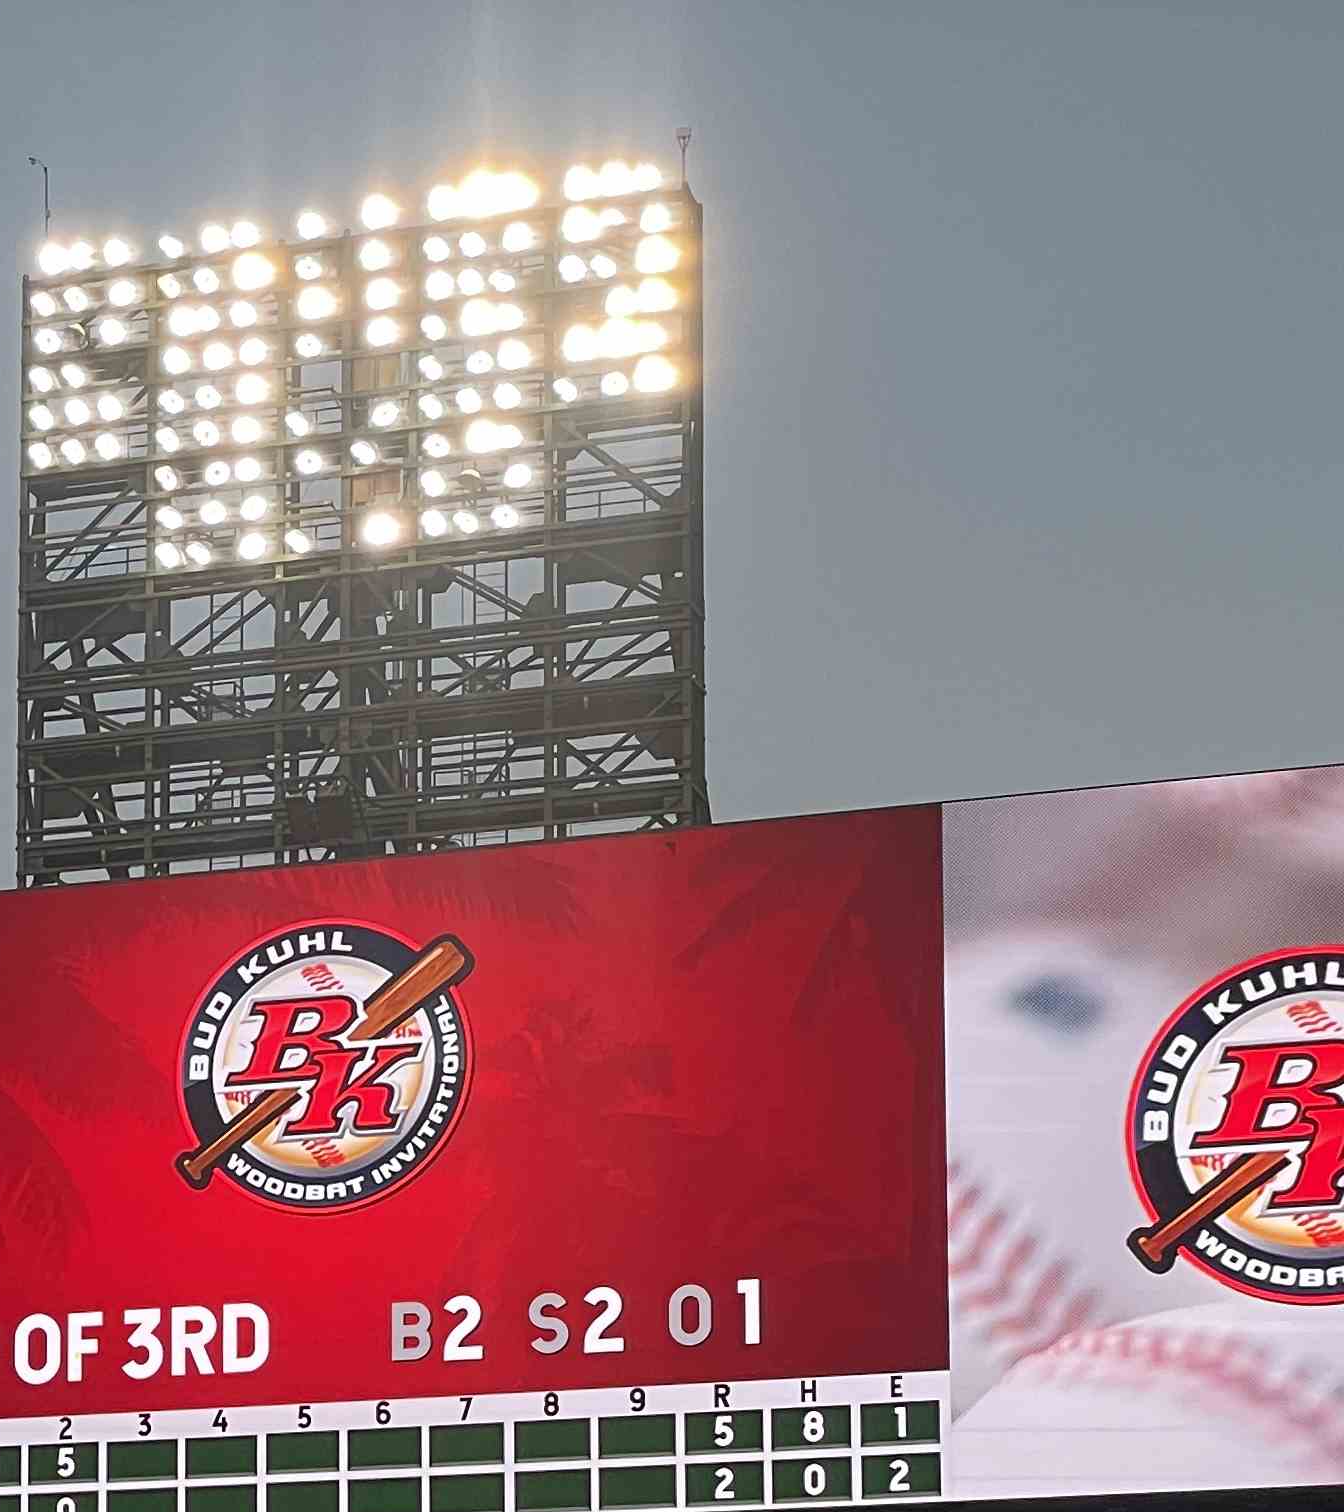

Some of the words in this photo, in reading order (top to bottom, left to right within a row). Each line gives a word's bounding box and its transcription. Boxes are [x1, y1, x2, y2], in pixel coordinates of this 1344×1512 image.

[189, 990, 232, 1081] BUD
[236, 931, 352, 985] KUHL
[225, 1152, 364, 1201] WOODBAT
[372, 994, 459, 1184] INVITATIONAL
[1142, 1034, 1198, 1143] BUD
[13, 1311, 105, 1384] OF
[121, 1303, 271, 1381] 3RD
[55, 1447, 76, 1478] 5
[713, 1414, 735, 1448] 5
[802, 1409, 826, 1444] 8
[892, 1405, 907, 1439] 1
[58, 1416, 73, 1441] 2
[137, 1412, 152, 1437] 3
[211, 1409, 229, 1434] 4
[296, 1406, 313, 1430] 5
[375, 1400, 392, 1425] 6
[459, 1397, 474, 1422] 7
[543, 1392, 560, 1418] 8
[629, 1388, 646, 1412] 9
[713, 1383, 731, 1408] R
[800, 1380, 817, 1403] H
[890, 1375, 903, 1398] E
[713, 1466, 736, 1499] 2
[802, 1462, 826, 1496] 0
[888, 1458, 912, 1492] 2
